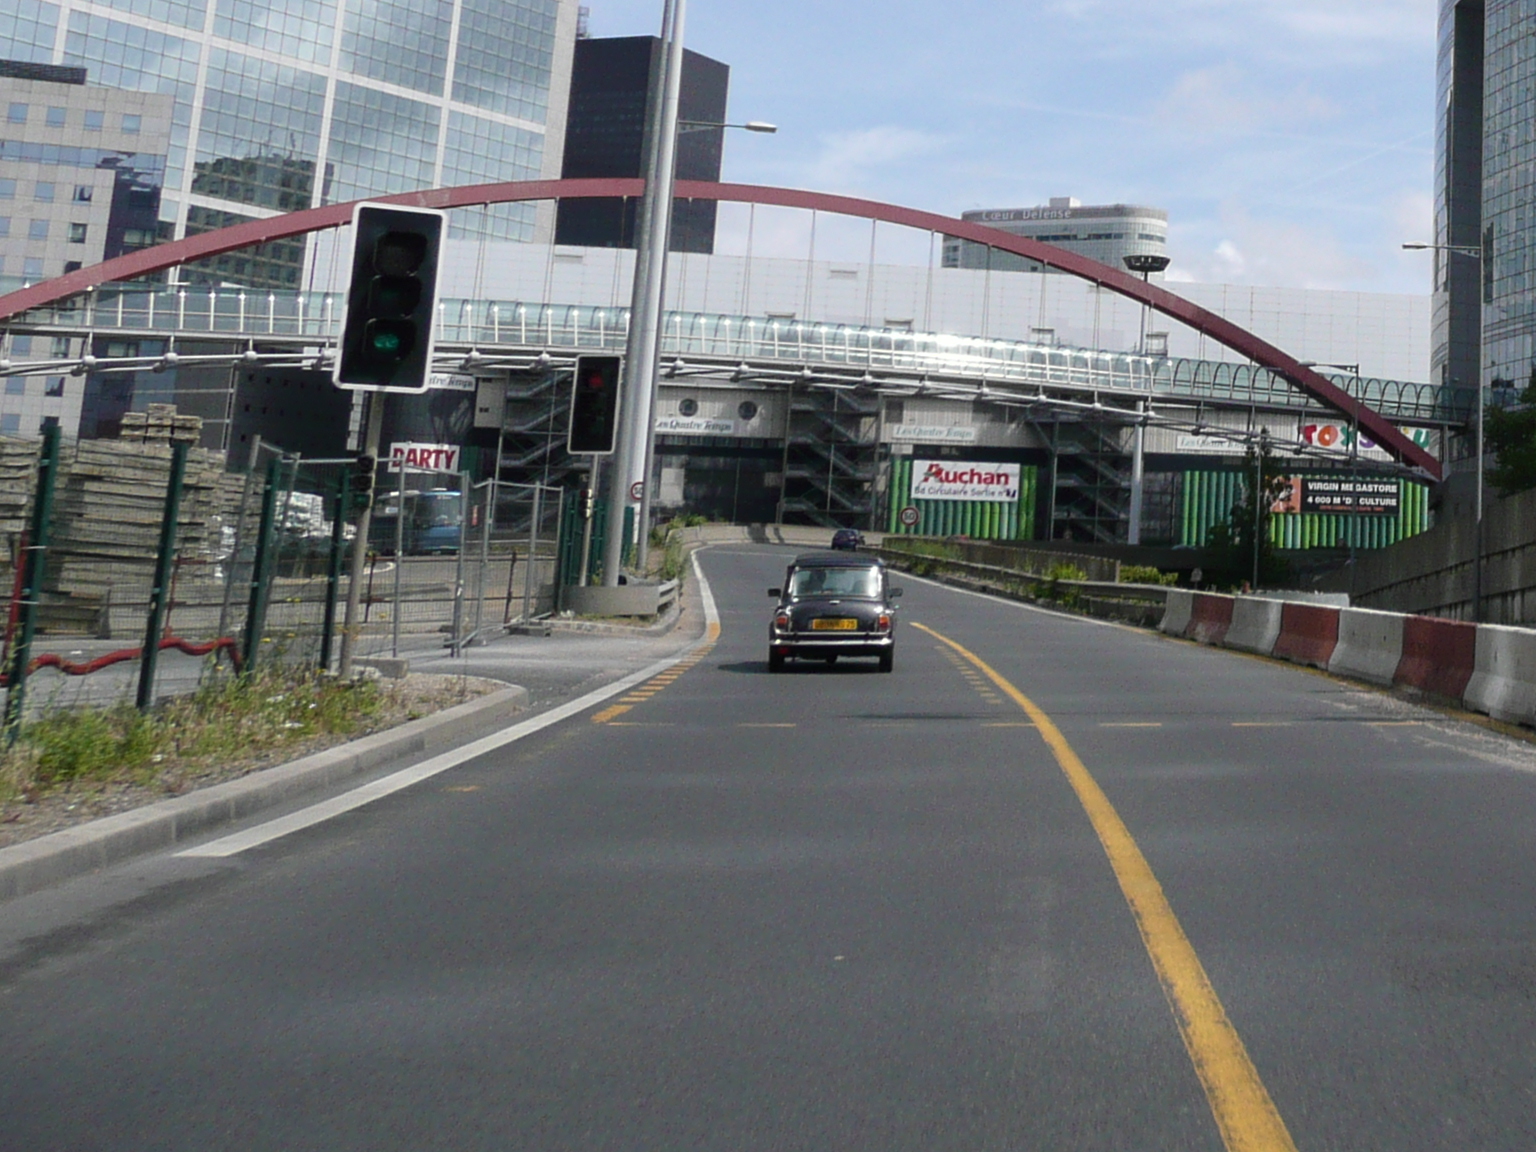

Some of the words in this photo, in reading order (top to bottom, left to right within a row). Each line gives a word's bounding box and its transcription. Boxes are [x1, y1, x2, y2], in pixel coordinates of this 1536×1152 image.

[392, 448, 456, 469] DARTY
[922, 463, 1009, 485] Auchan
[1307, 482, 1339, 491] VIRGIN
[1341, 483, 1398, 493] MEGASTORE
[927, 488, 968, 497] Circulaire
[970, 489, 995, 498] Sortie
[1307, 496, 1313, 504] 4
[1359, 497, 1397, 506] CULTURE
[904, 512, 915, 521] 50
